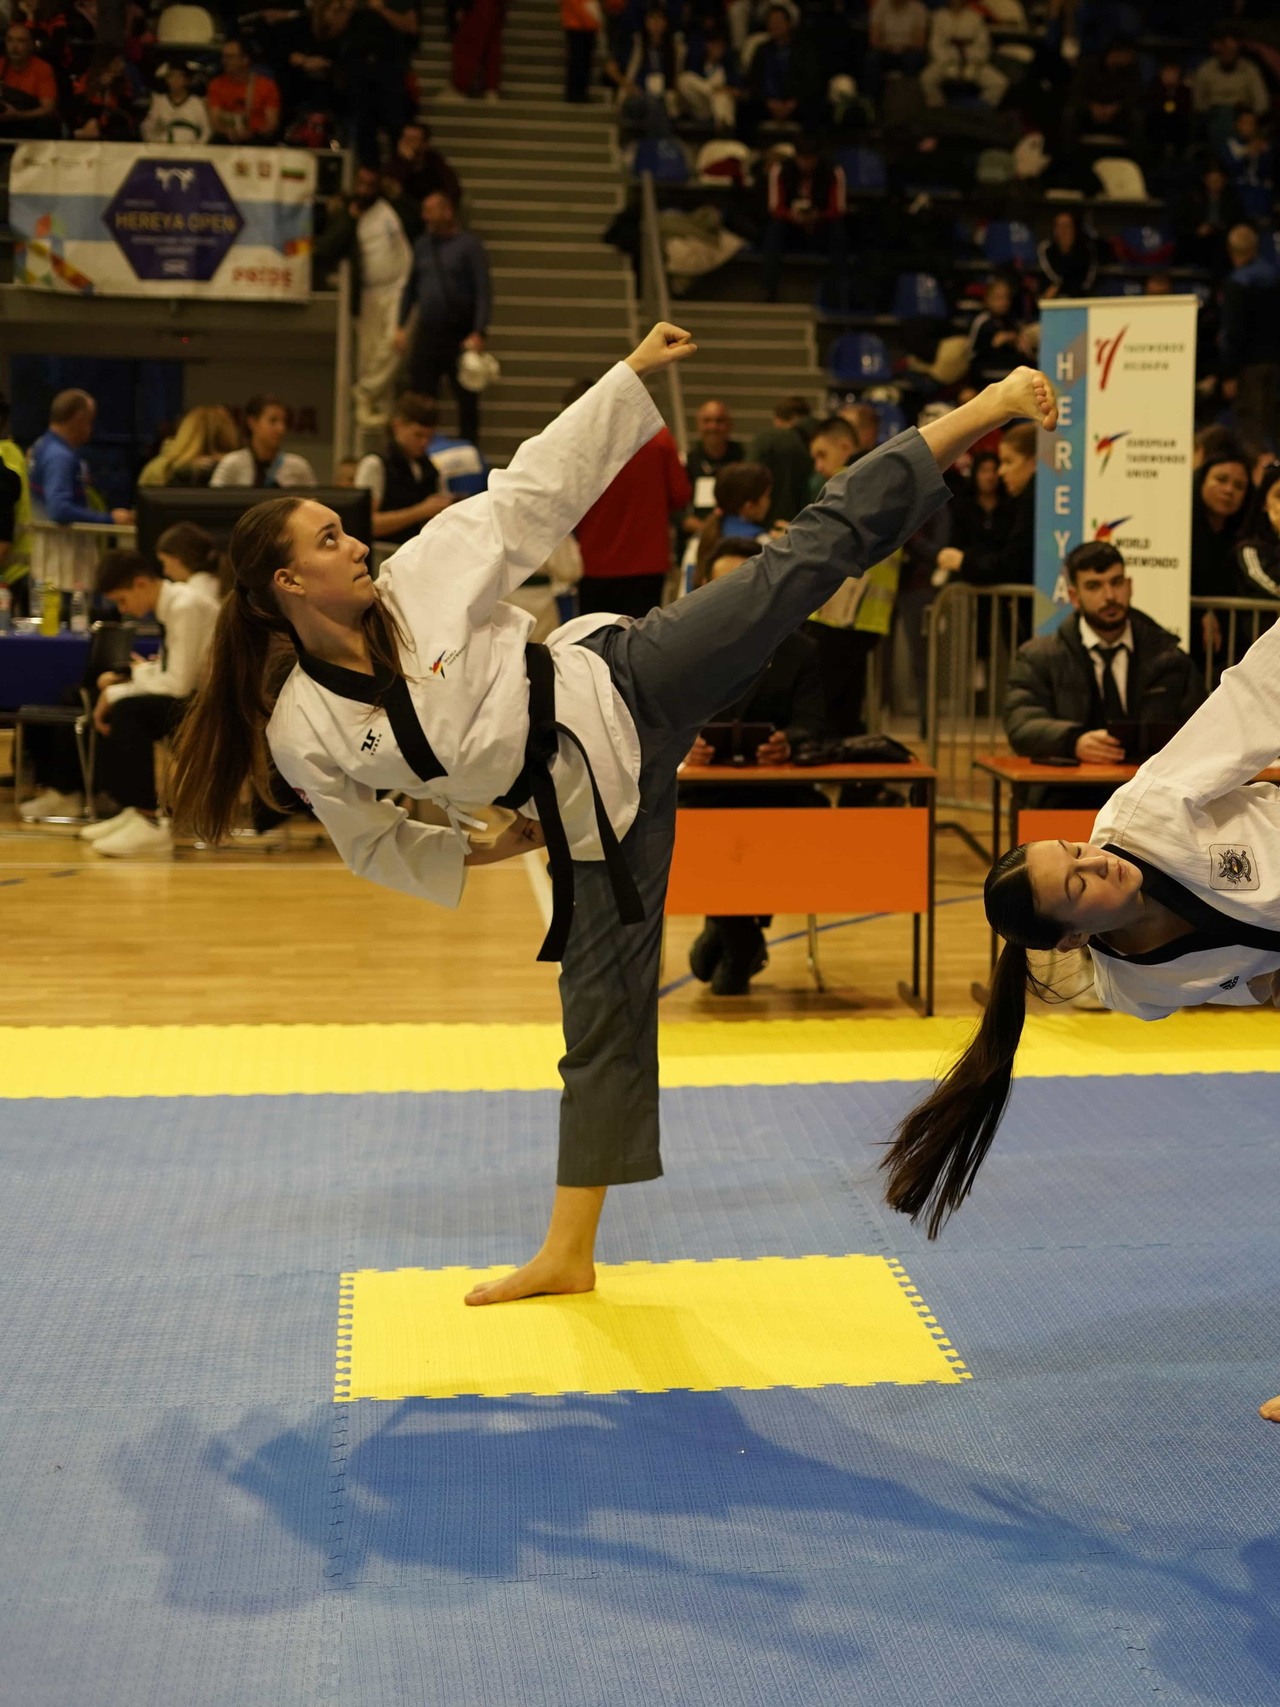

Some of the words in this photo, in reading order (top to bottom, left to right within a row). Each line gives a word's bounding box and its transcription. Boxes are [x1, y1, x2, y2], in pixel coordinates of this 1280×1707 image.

[115, 211, 185, 231] HEREYA
[187, 212, 237, 233] OPEN
[1126, 438, 1178, 448] EUROPEAN
[1052, 352, 1075, 604] HEREYA
[1126, 468, 1159, 479] UNION
[1115, 537, 1152, 549] WORLD
[1124, 556, 1179, 569] EKWONDO
